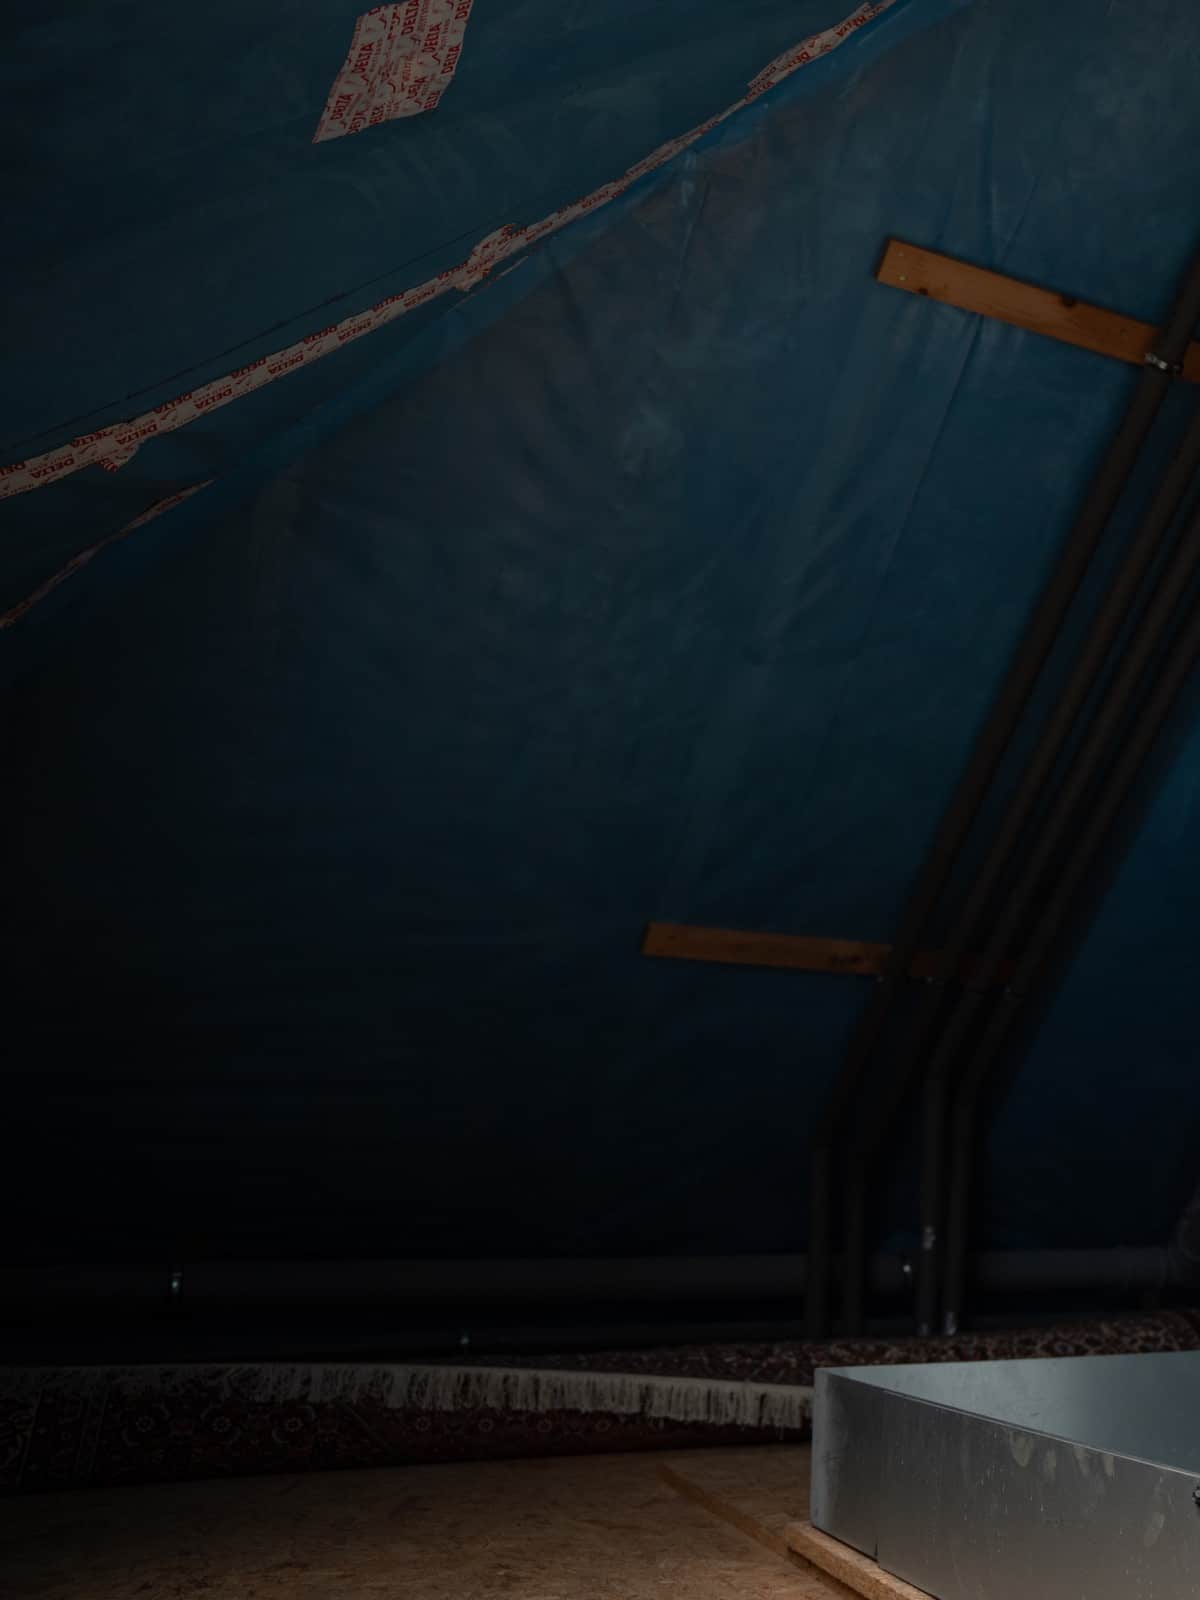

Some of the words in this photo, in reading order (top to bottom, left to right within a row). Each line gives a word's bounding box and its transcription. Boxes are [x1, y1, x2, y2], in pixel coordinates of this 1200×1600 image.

[194, 387, 233, 411] DELTA
[116, 423, 158, 445] DELTA
[30, 457, 75, 479] DELTA
